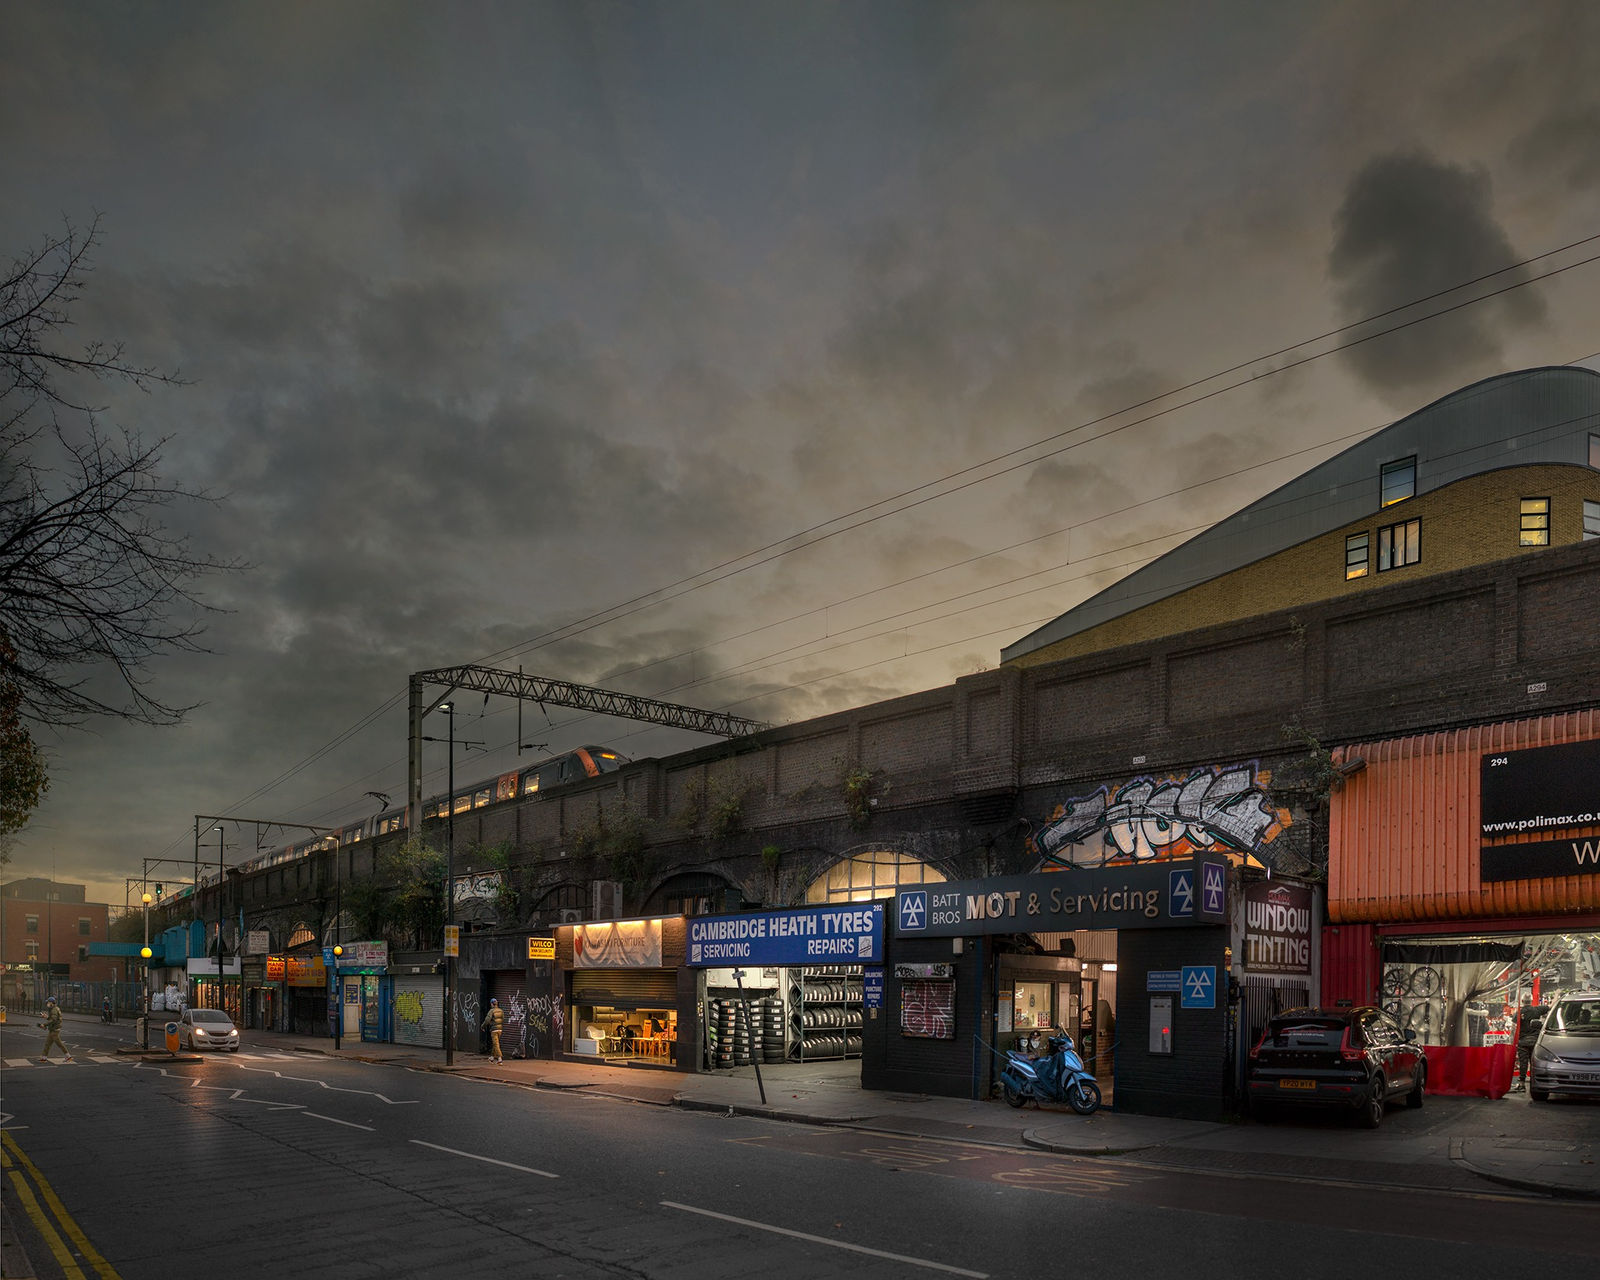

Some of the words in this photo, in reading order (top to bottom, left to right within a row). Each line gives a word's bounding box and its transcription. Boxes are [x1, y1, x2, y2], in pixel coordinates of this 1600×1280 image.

[1490, 757, 1508, 767] 294
[932, 893, 960, 908] BATT
[965, 890, 1021, 920] MOT
[1026, 899, 1040, 915] &
[1050, 885, 1159, 919] Servicing
[692, 918, 766, 941] CAMBRIDGE
[770, 914, 817, 937] HEATH
[822, 911, 873, 934] TYRES
[932, 910, 960, 925] BROS
[1247, 900, 1309, 935] WINDOW
[532, 940, 552, 948] WILCO
[704, 942, 750, 958] SERVICING
[808, 938, 855, 955] REPAIRS
[1246, 933, 1309, 965] TINTING
